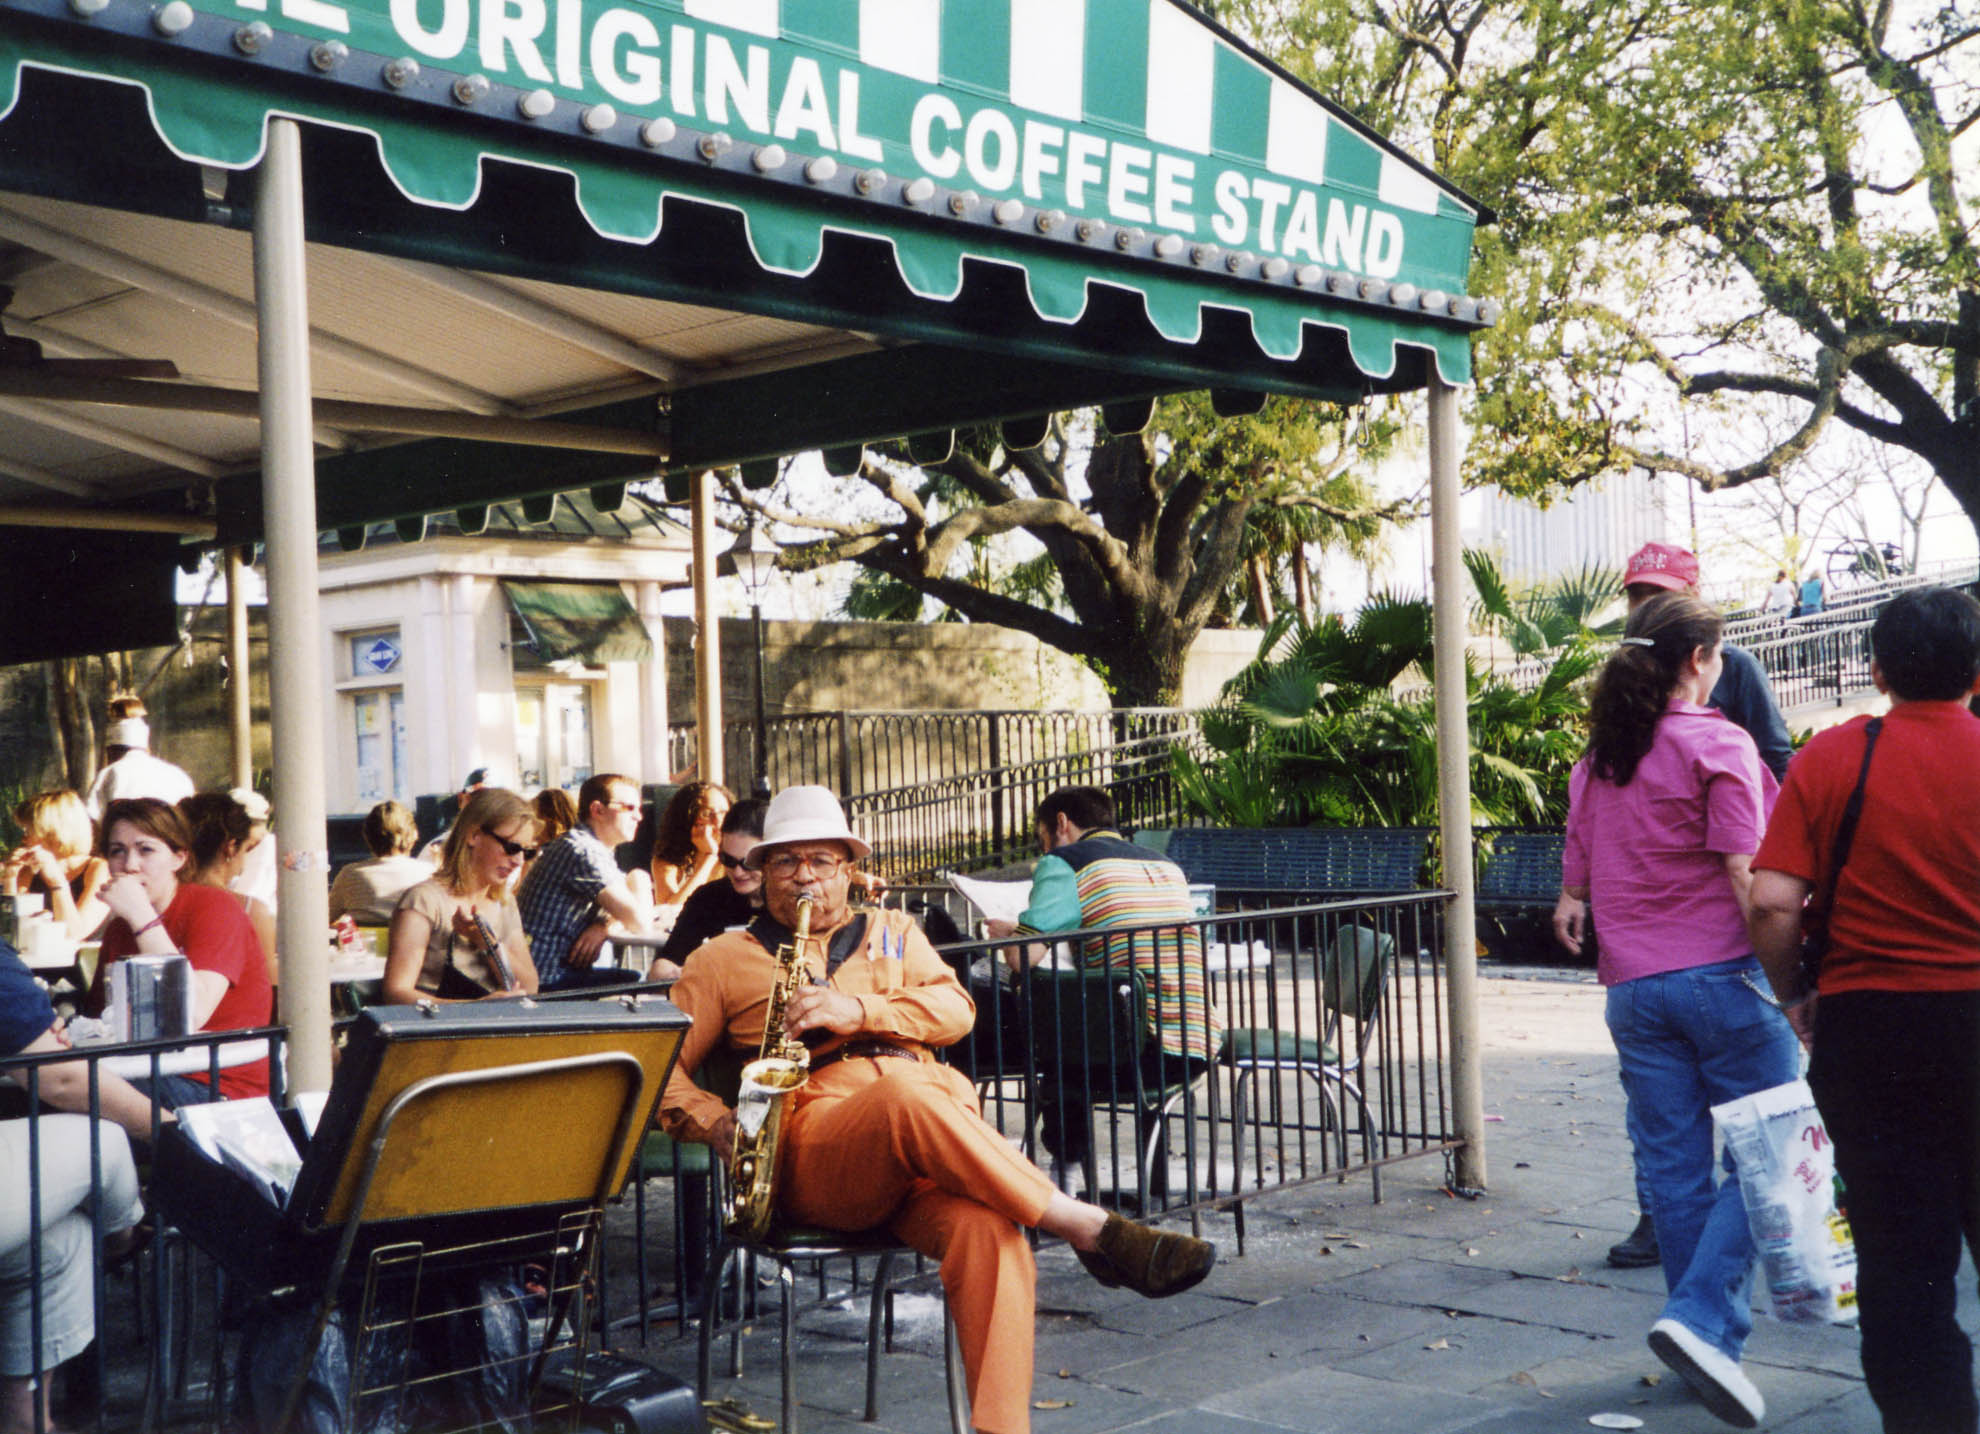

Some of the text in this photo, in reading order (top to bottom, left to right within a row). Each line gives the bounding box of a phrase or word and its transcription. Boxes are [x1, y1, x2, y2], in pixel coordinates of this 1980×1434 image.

[390, 0, 1404, 278] ORIGINAL COFFEE STAND
